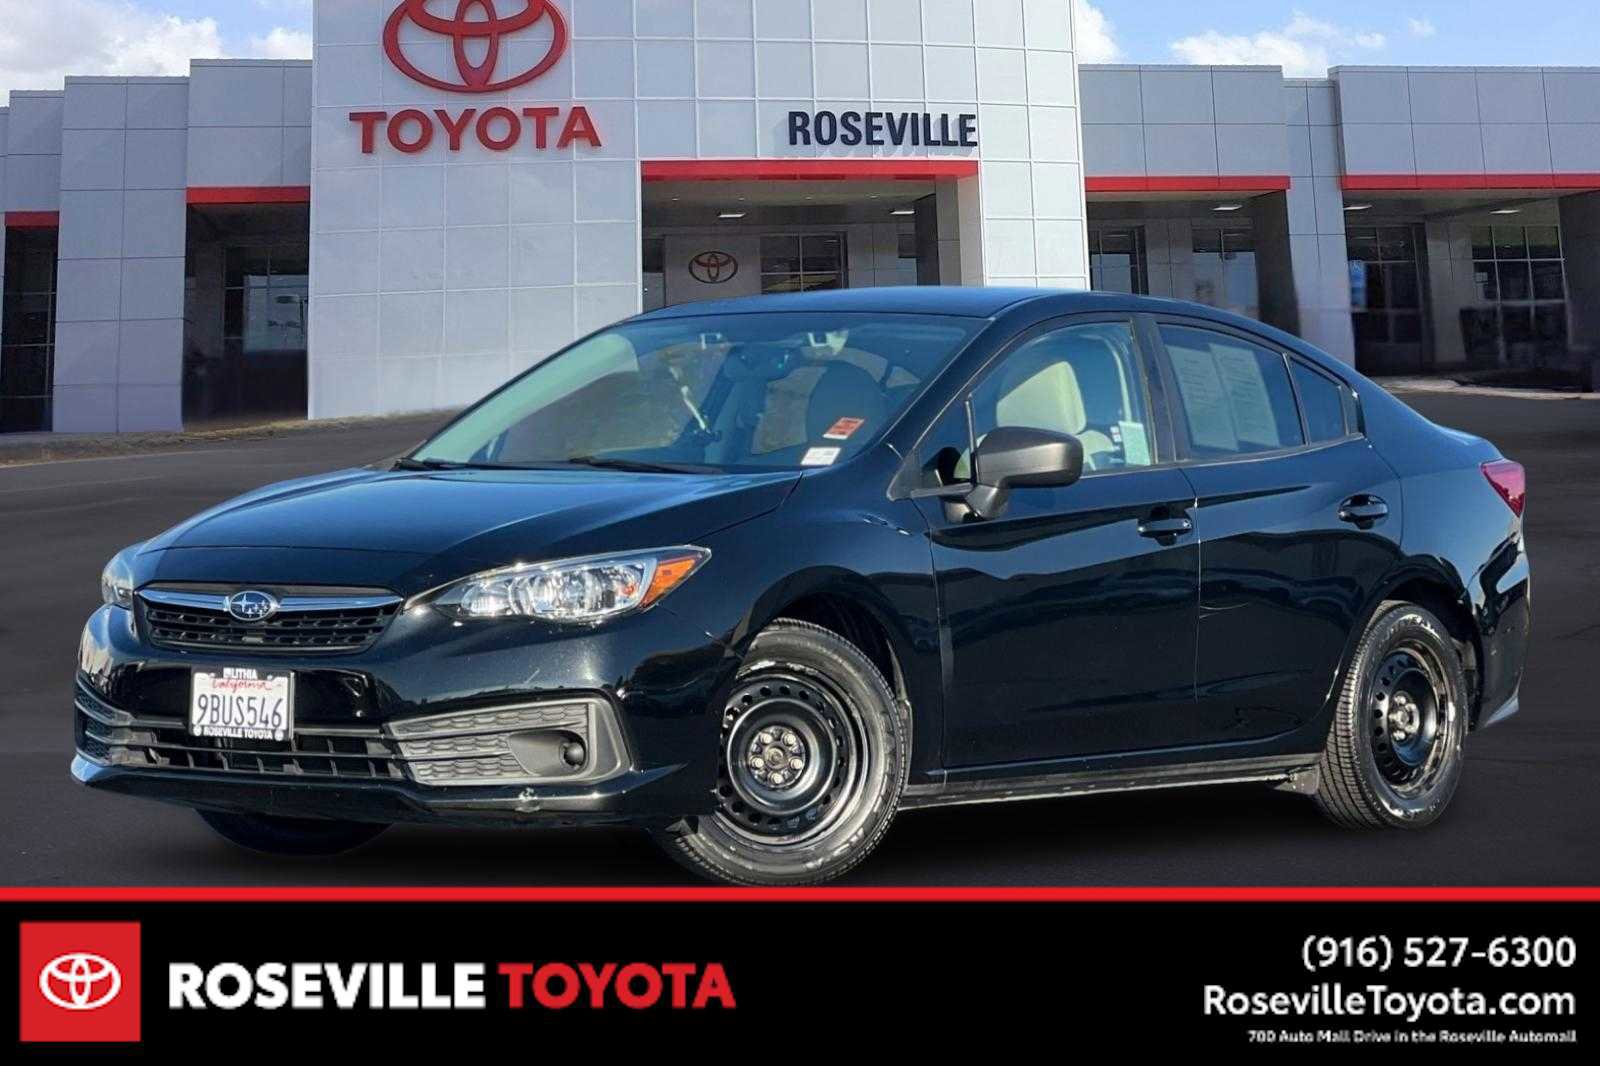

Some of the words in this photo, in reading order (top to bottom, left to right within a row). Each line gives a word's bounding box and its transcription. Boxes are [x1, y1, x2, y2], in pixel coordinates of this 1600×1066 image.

[349, 106, 602, 154] TOYOTA
[788, 110, 978, 147] ROSEVILLE
[211, 678, 272, 693] California
[197, 693, 284, 728] 9BUS546
[203, 726, 243, 738] ROSEVILLE
[244, 727, 273, 740] TOYOTA
